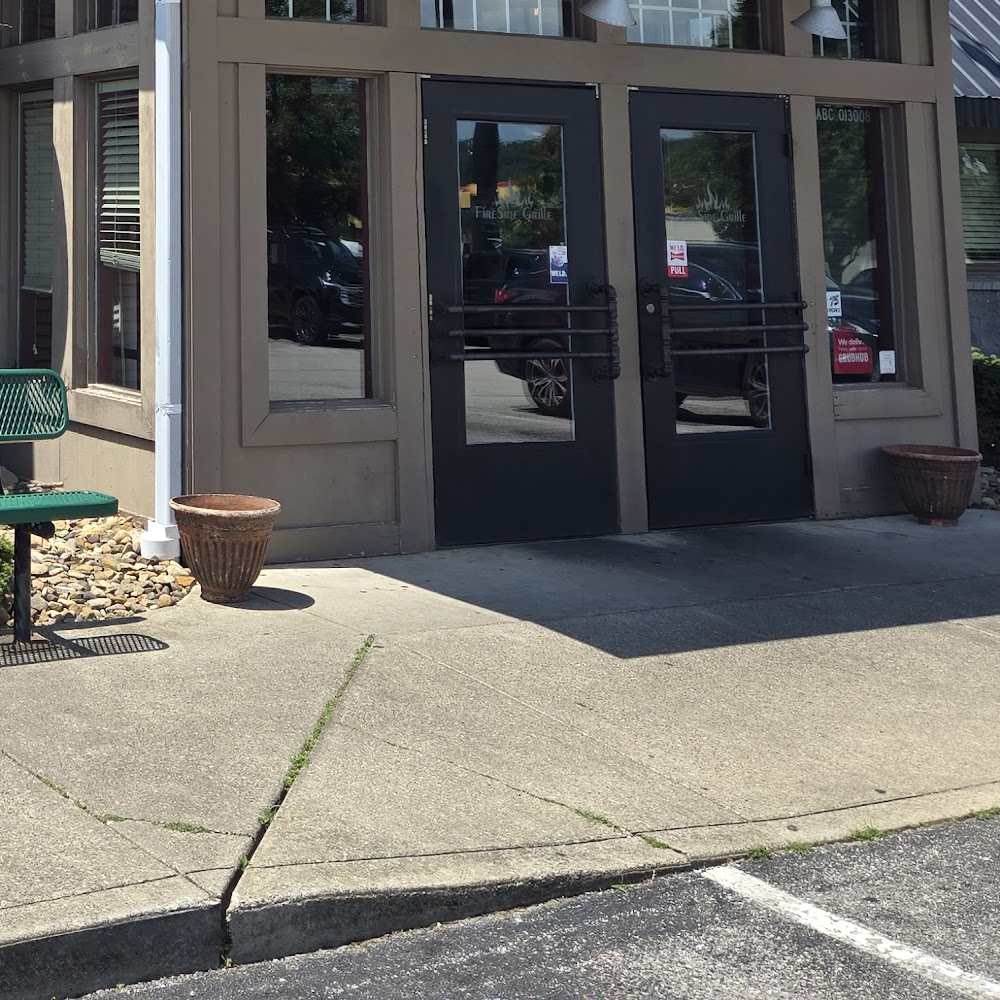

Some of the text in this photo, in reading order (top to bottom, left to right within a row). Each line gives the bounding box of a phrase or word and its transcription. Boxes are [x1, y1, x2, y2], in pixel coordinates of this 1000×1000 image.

[816, 107, 834, 121] ABC
[670, 266, 686, 275] PULL
[838, 338, 848, 346] We
[838, 352, 869, 363] GRUBHUB
